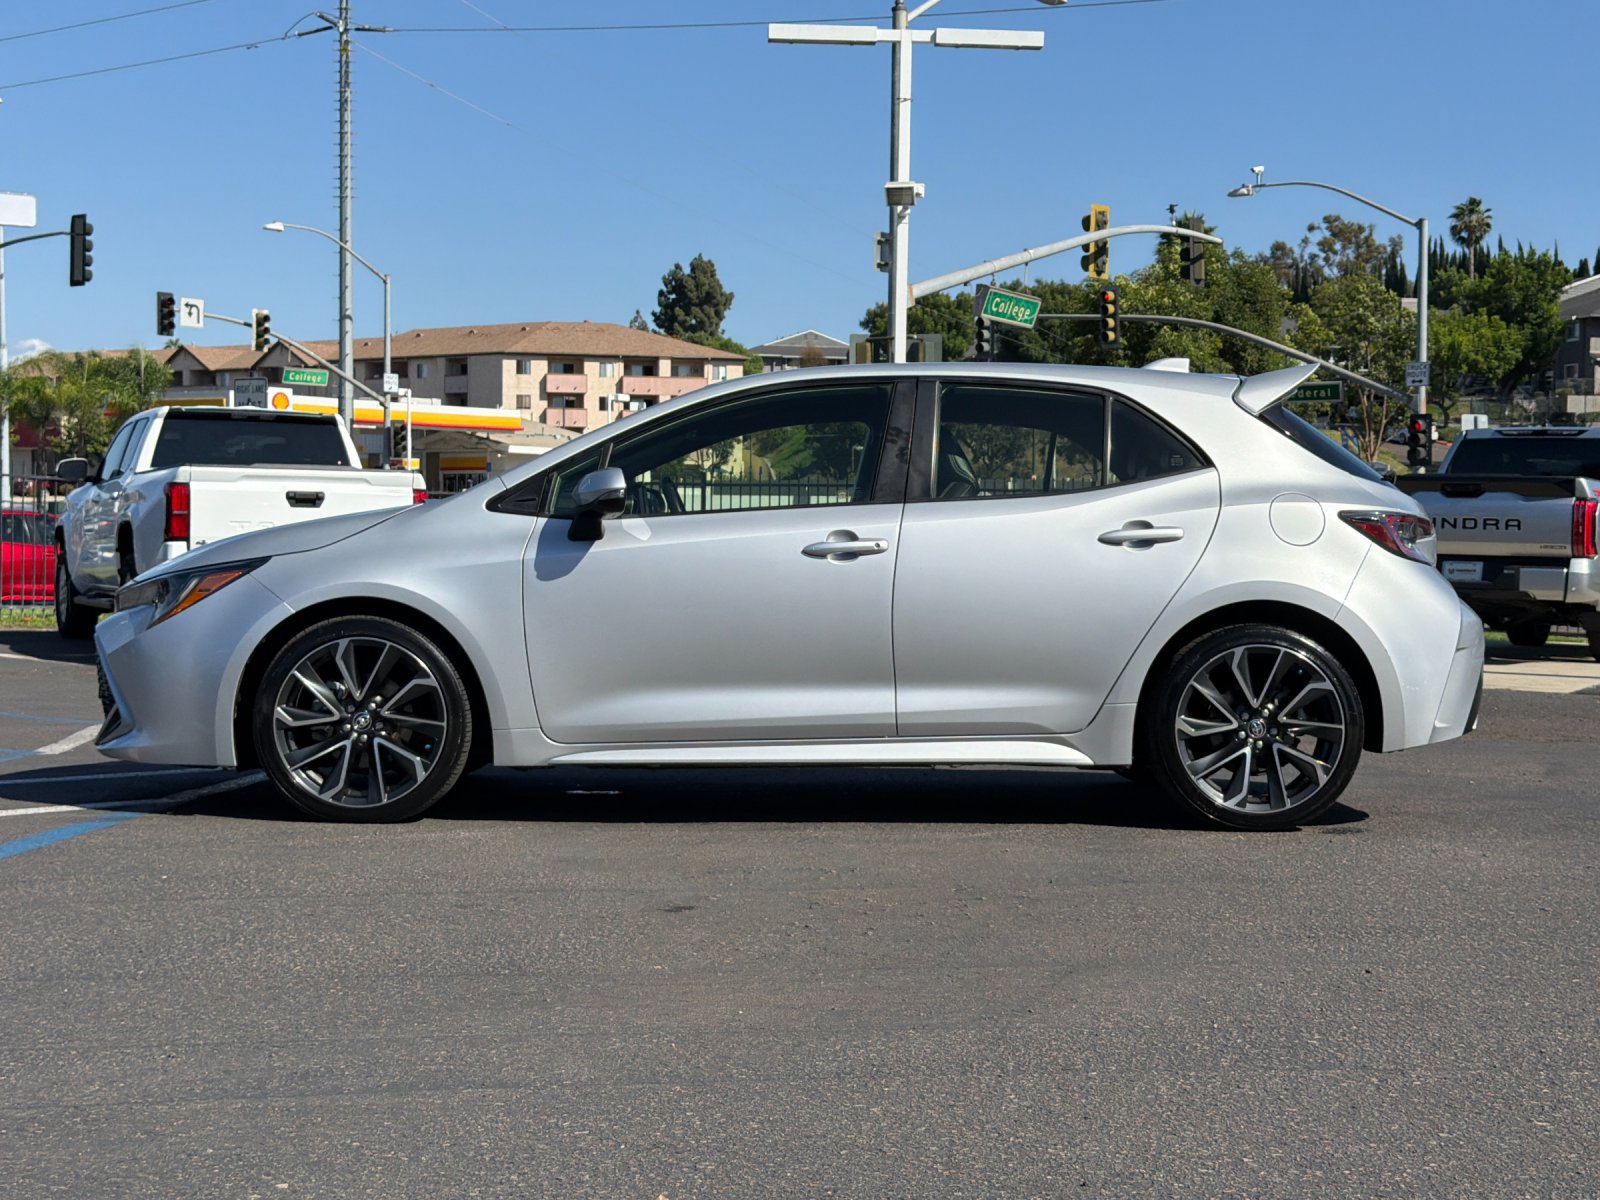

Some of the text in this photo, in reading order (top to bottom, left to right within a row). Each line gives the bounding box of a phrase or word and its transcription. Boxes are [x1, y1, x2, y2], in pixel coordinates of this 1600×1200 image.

[991, 297, 1031, 321] College
[289, 372, 322, 383] College
[1297, 387, 1331, 398] deral
[1432, 517, 1522, 531] NDRA
